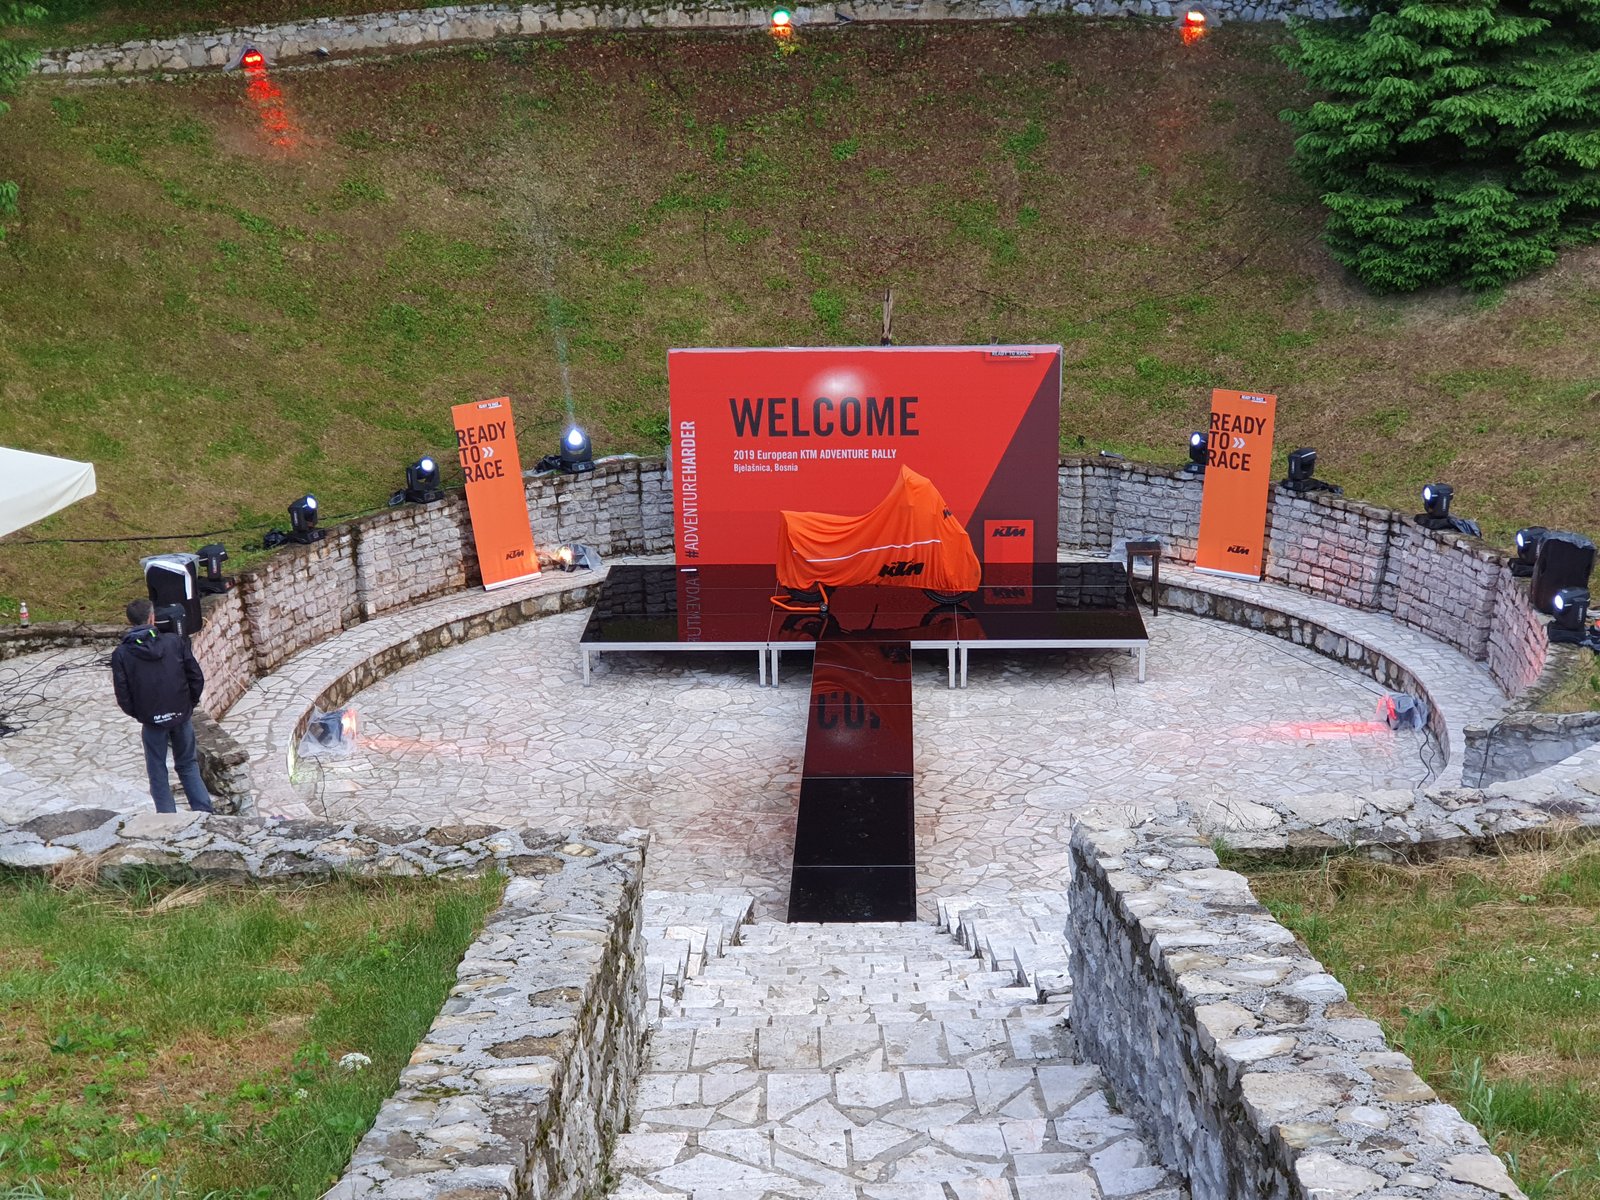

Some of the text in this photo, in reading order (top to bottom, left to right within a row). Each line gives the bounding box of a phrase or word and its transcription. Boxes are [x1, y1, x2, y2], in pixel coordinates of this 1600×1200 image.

[729, 396, 919, 438] WELCOME
[1209, 412, 1267, 436] READY
[455, 421, 507, 448] READY
[1208, 431, 1230, 450] TO
[459, 446, 481, 465] TO
[733, 448, 897, 462] 2019 European KTM ADVENTURE RALLY
[1206, 449, 1251, 472] RACE
[462, 459, 505, 484] RACE
[733, 462, 798, 474] Bjelašnica, Bosnia
[680, 420, 699, 559] #ADVENTUREHARDER
[992, 525, 1026, 537] KTM
[505, 549, 525, 560] KTM
[1227, 544, 1250, 556] KTM
[877, 559, 925, 578] KTM
